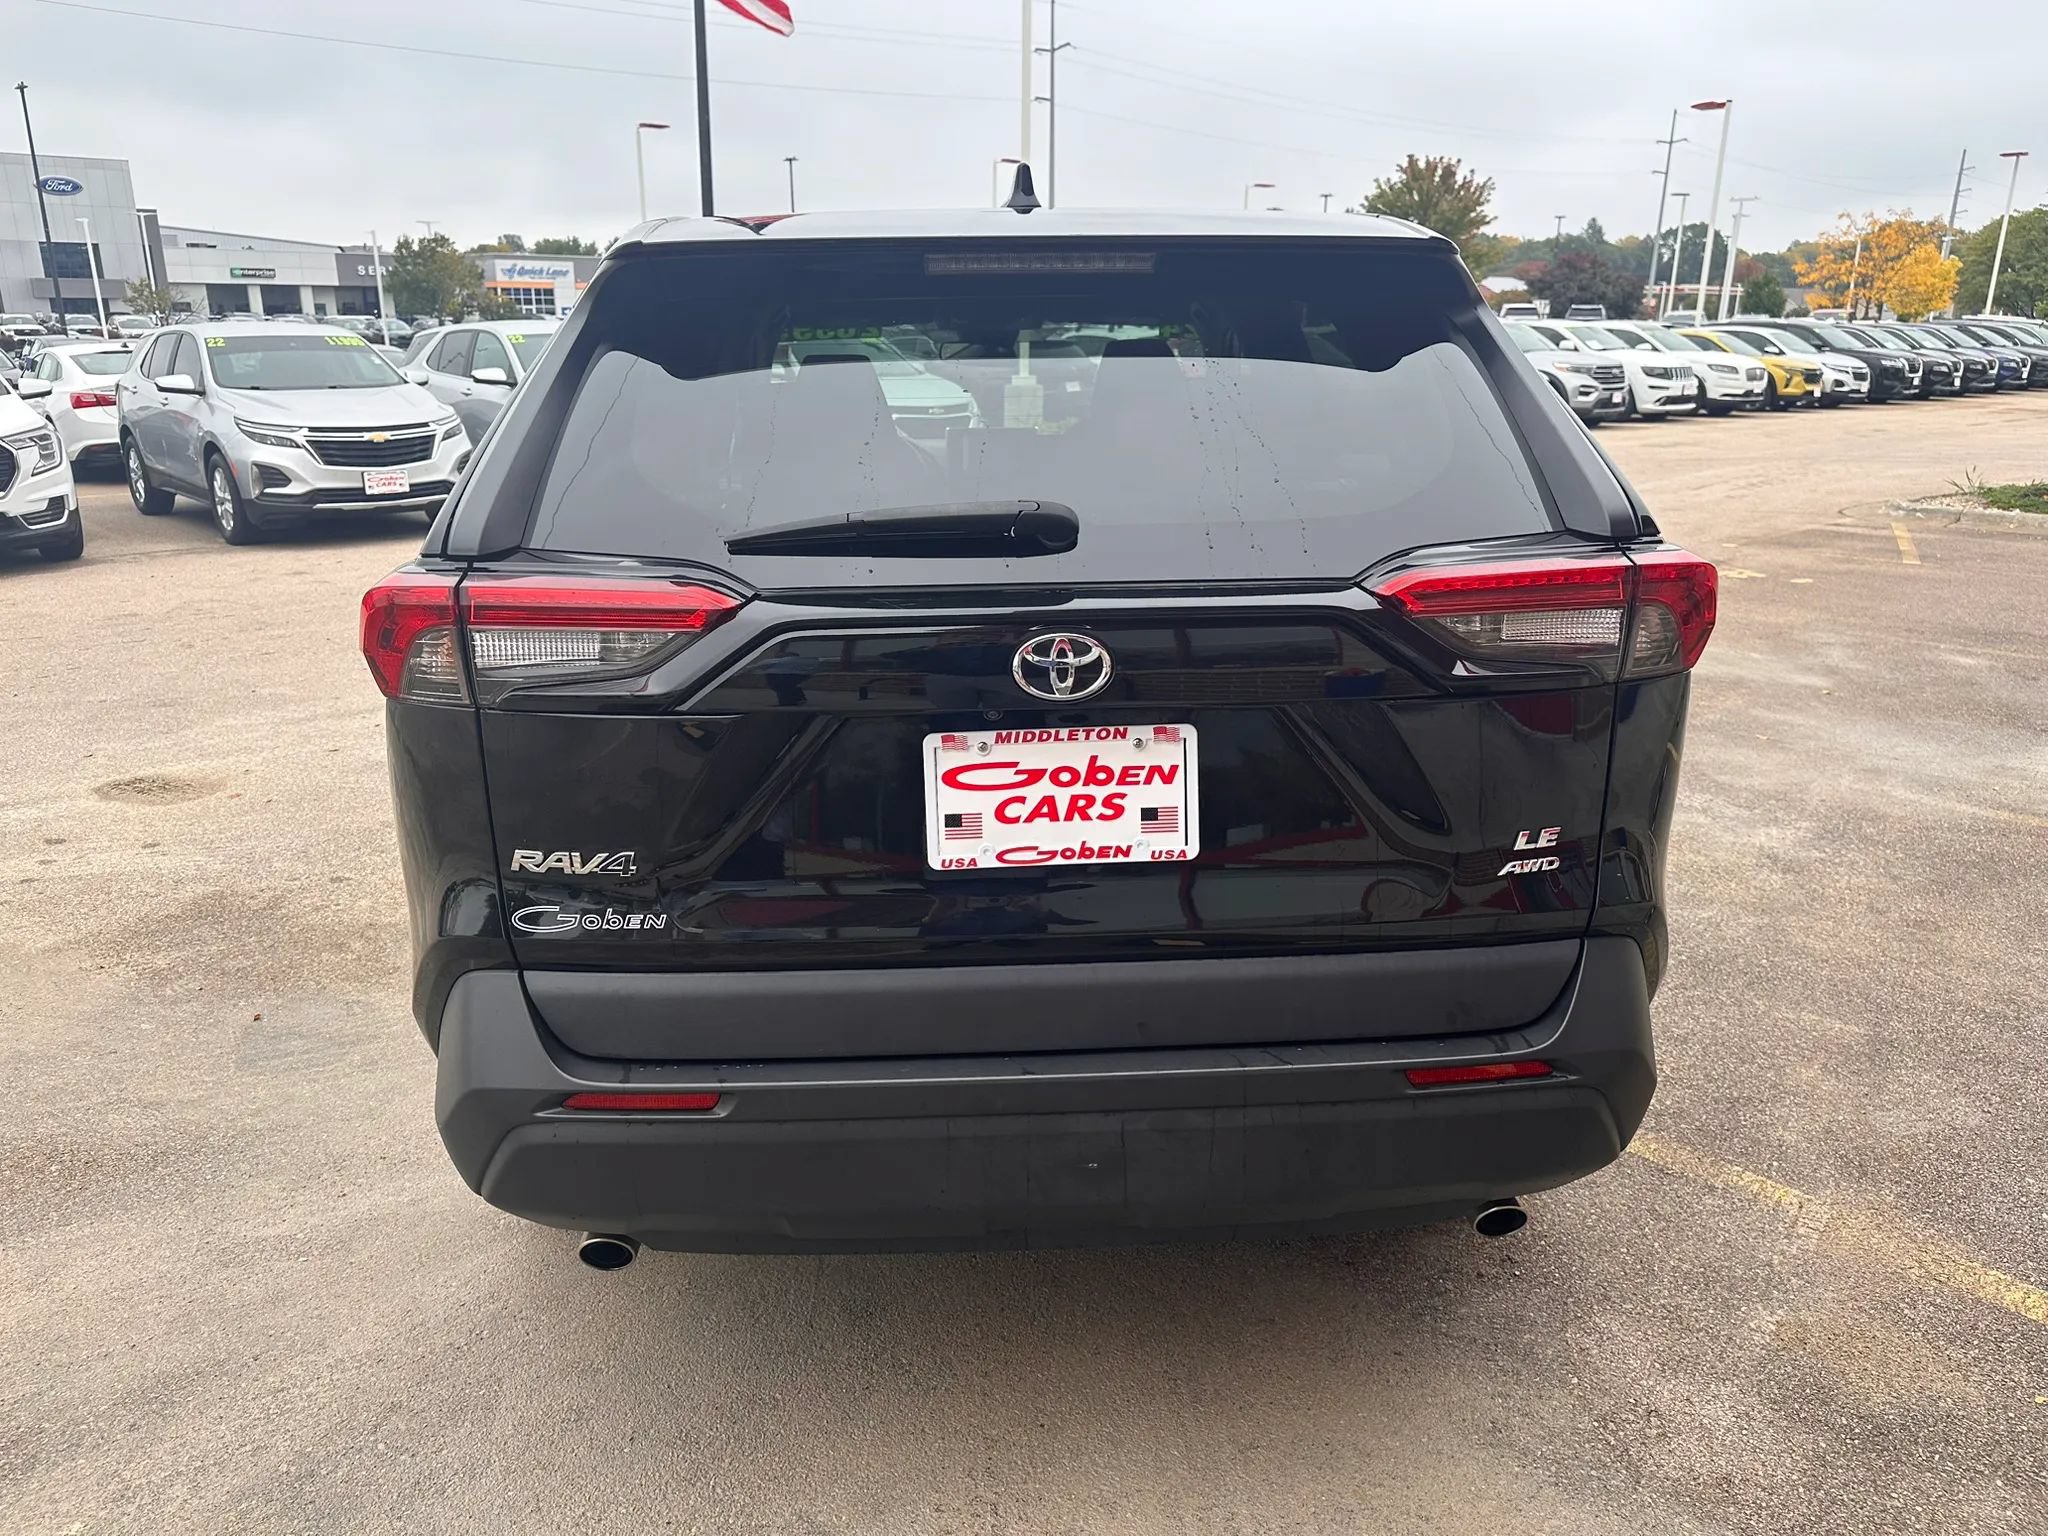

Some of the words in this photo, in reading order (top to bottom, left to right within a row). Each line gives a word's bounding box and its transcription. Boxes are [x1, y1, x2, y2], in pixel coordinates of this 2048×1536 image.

[45, 179, 74, 192] Ford
[357, 265, 393, 276] SER
[206, 337, 226, 347] 22
[508, 335, 526, 344] 22
[994, 727, 1129, 745] MIDDLETON
[994, 792, 1129, 825] CARS
[1513, 826, 1562, 851] LE
[1150, 849, 1188, 861] USA
[510, 849, 638, 877] RAV4
[941, 857, 978, 870] USA
[1497, 856, 1560, 877] AWD
